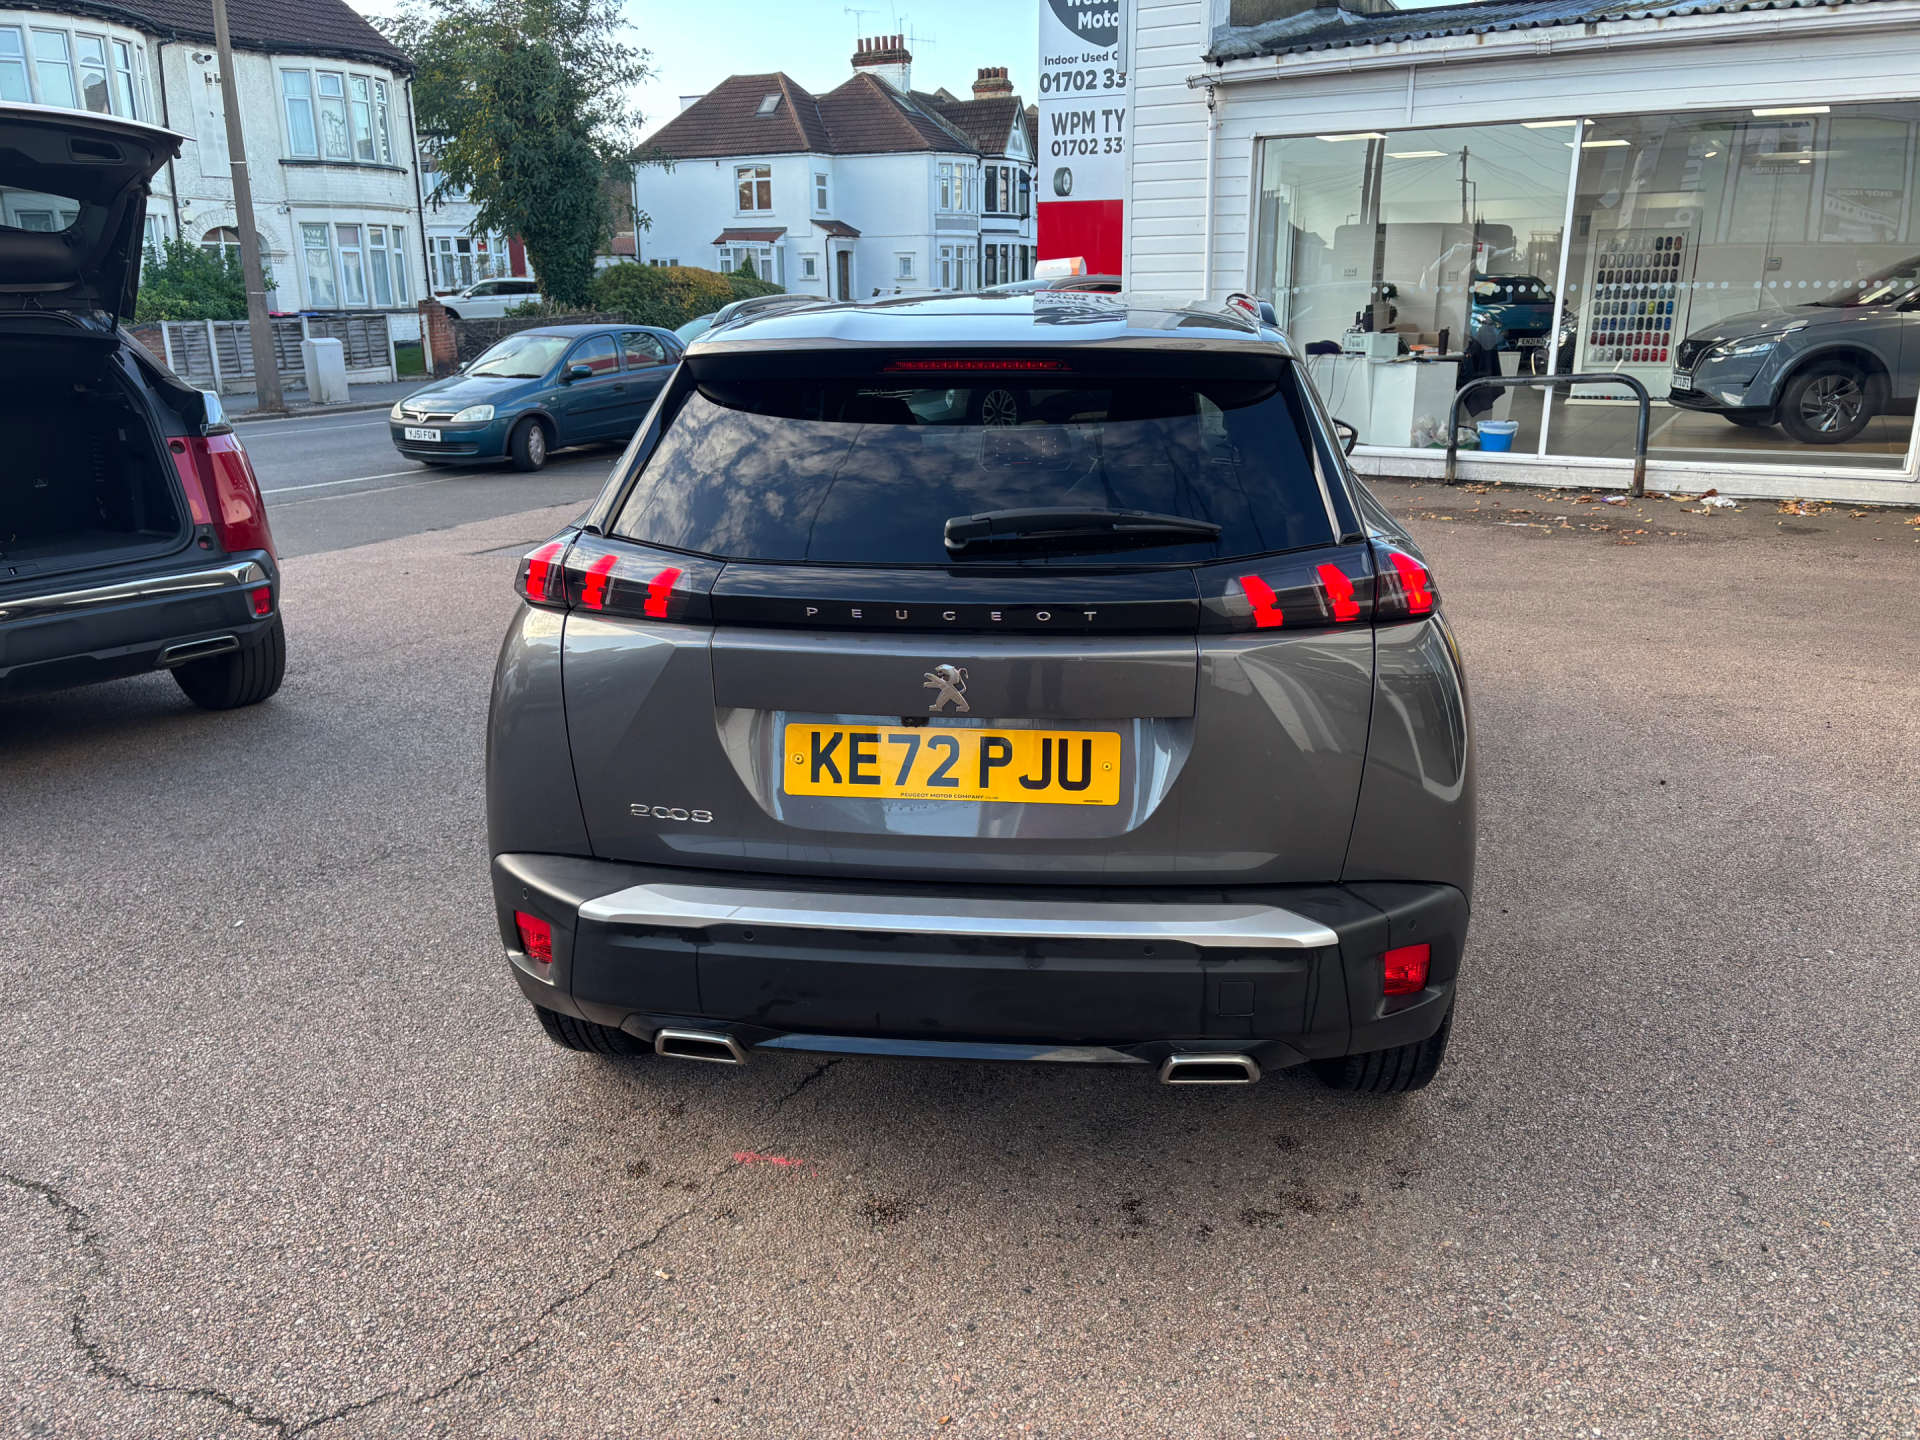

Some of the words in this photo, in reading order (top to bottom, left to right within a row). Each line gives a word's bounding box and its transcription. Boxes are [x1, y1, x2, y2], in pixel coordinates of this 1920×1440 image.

[1044, 56, 1079, 66] Indoor
[1081, 51, 1109, 63] Used
[1040, 69, 1097, 93] 01702
[1051, 110, 1095, 136] WPM
[1102, 108, 1126, 133] TY
[1051, 138, 1098, 157] 01702
[1103, 137, 1126, 154] 33
[806, 607, 1098, 622] PEUGEOT
[810, 731, 960, 787] KE72
[980, 736, 1092, 791] PJU
[629, 803, 714, 823] 2008
